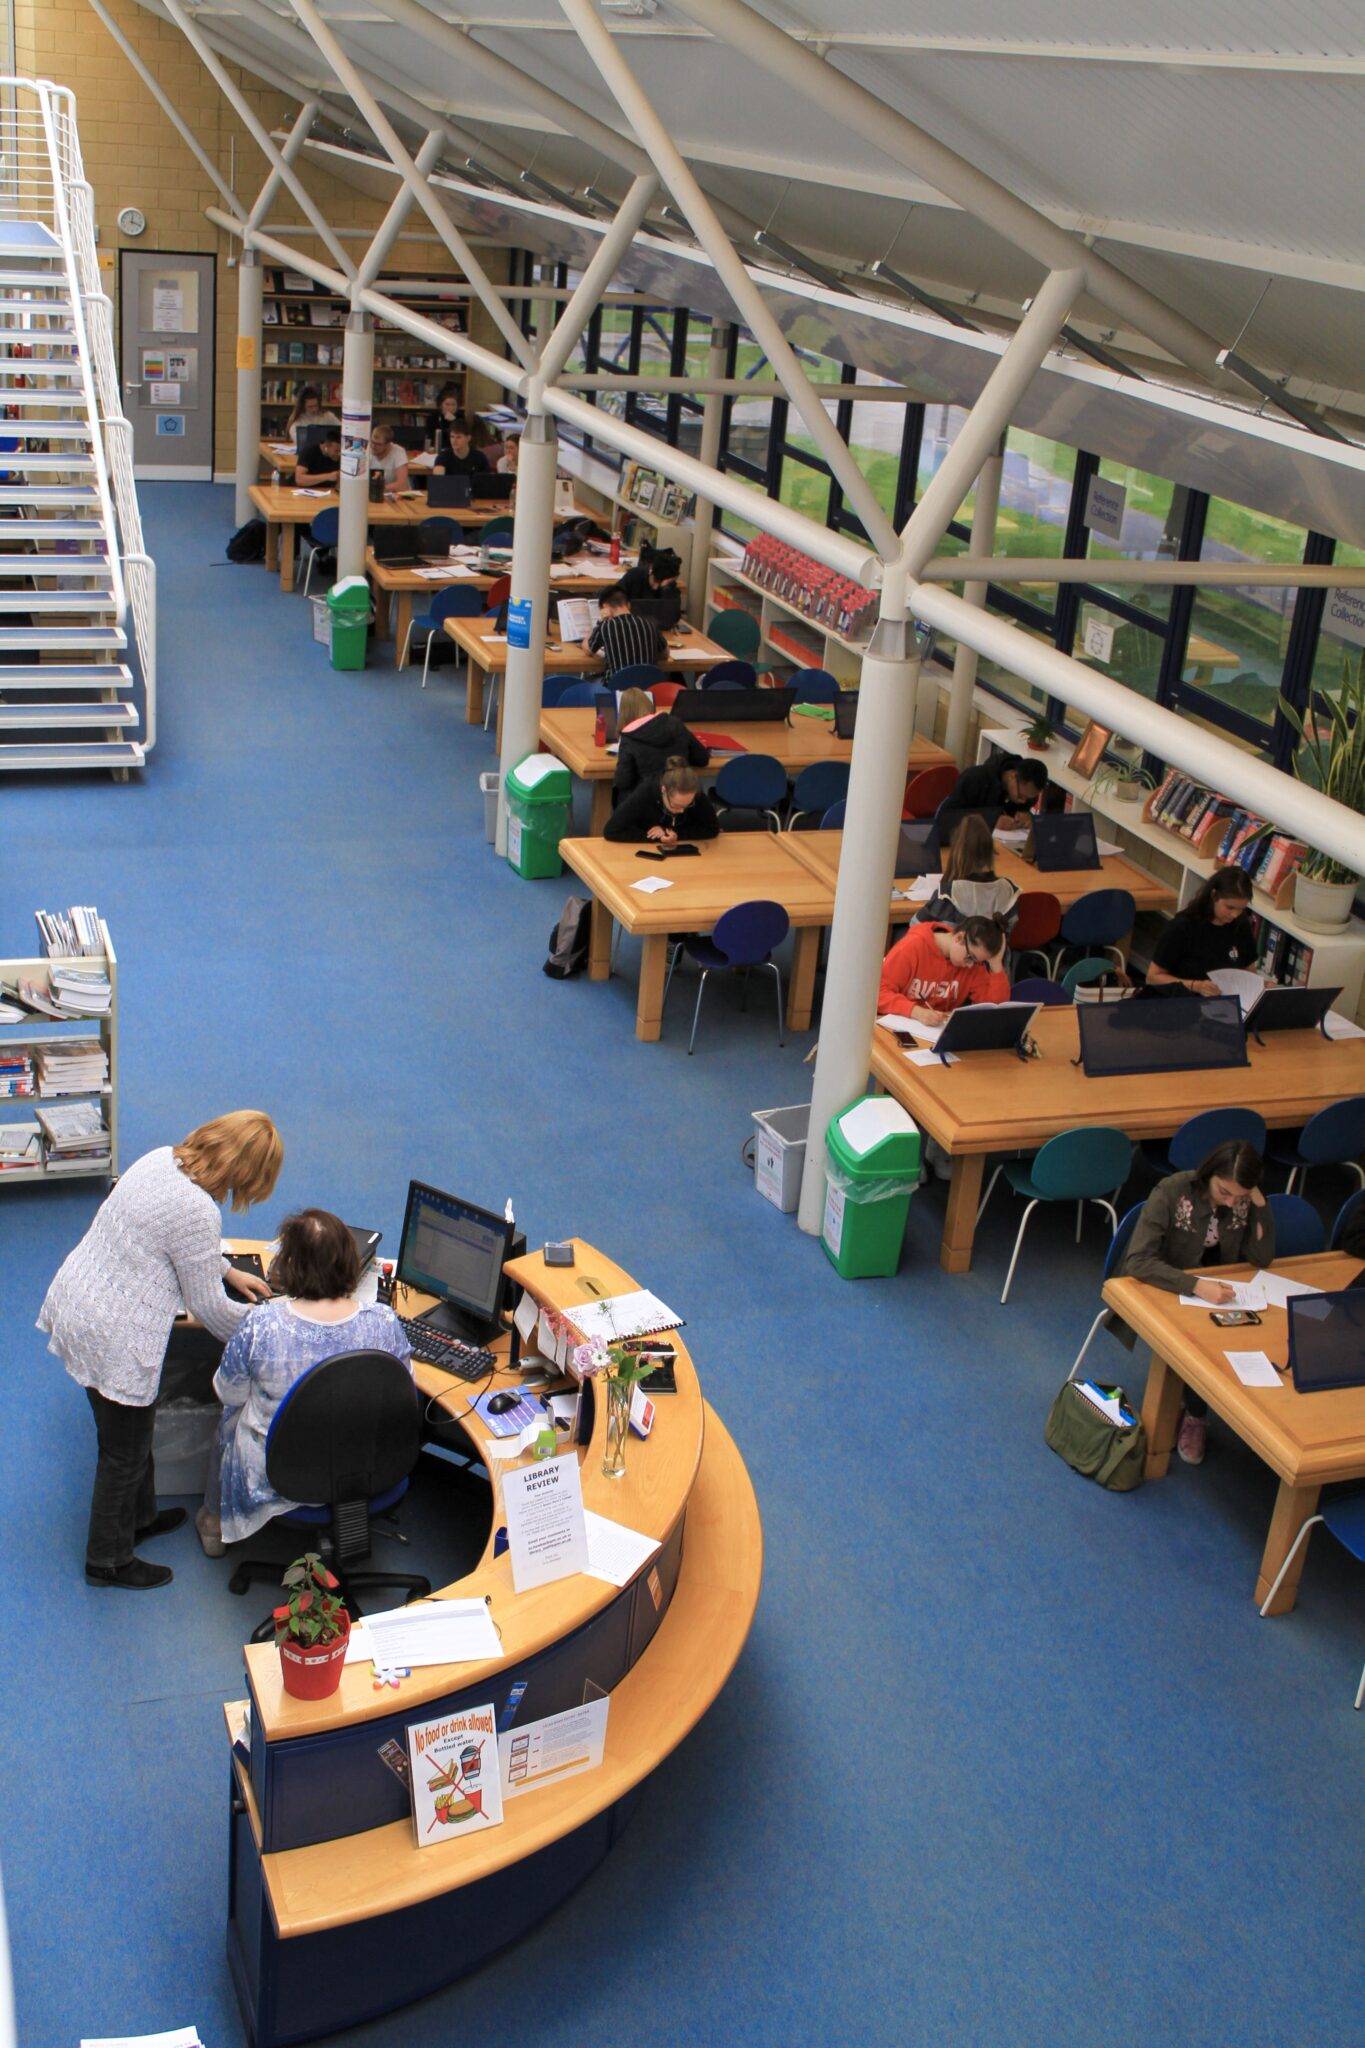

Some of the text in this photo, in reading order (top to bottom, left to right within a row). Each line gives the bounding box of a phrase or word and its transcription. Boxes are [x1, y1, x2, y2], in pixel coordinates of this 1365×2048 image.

[1335, 587, 1365, 611] Referenc
[523, 1465, 560, 1483] LIBRARY
[526, 1476, 559, 1492] REVIEW
[415, 1710, 494, 1755] No food or drink allowed
[443, 1734, 463, 1743] Except
[434, 1739, 474, 1753] Bottled water
